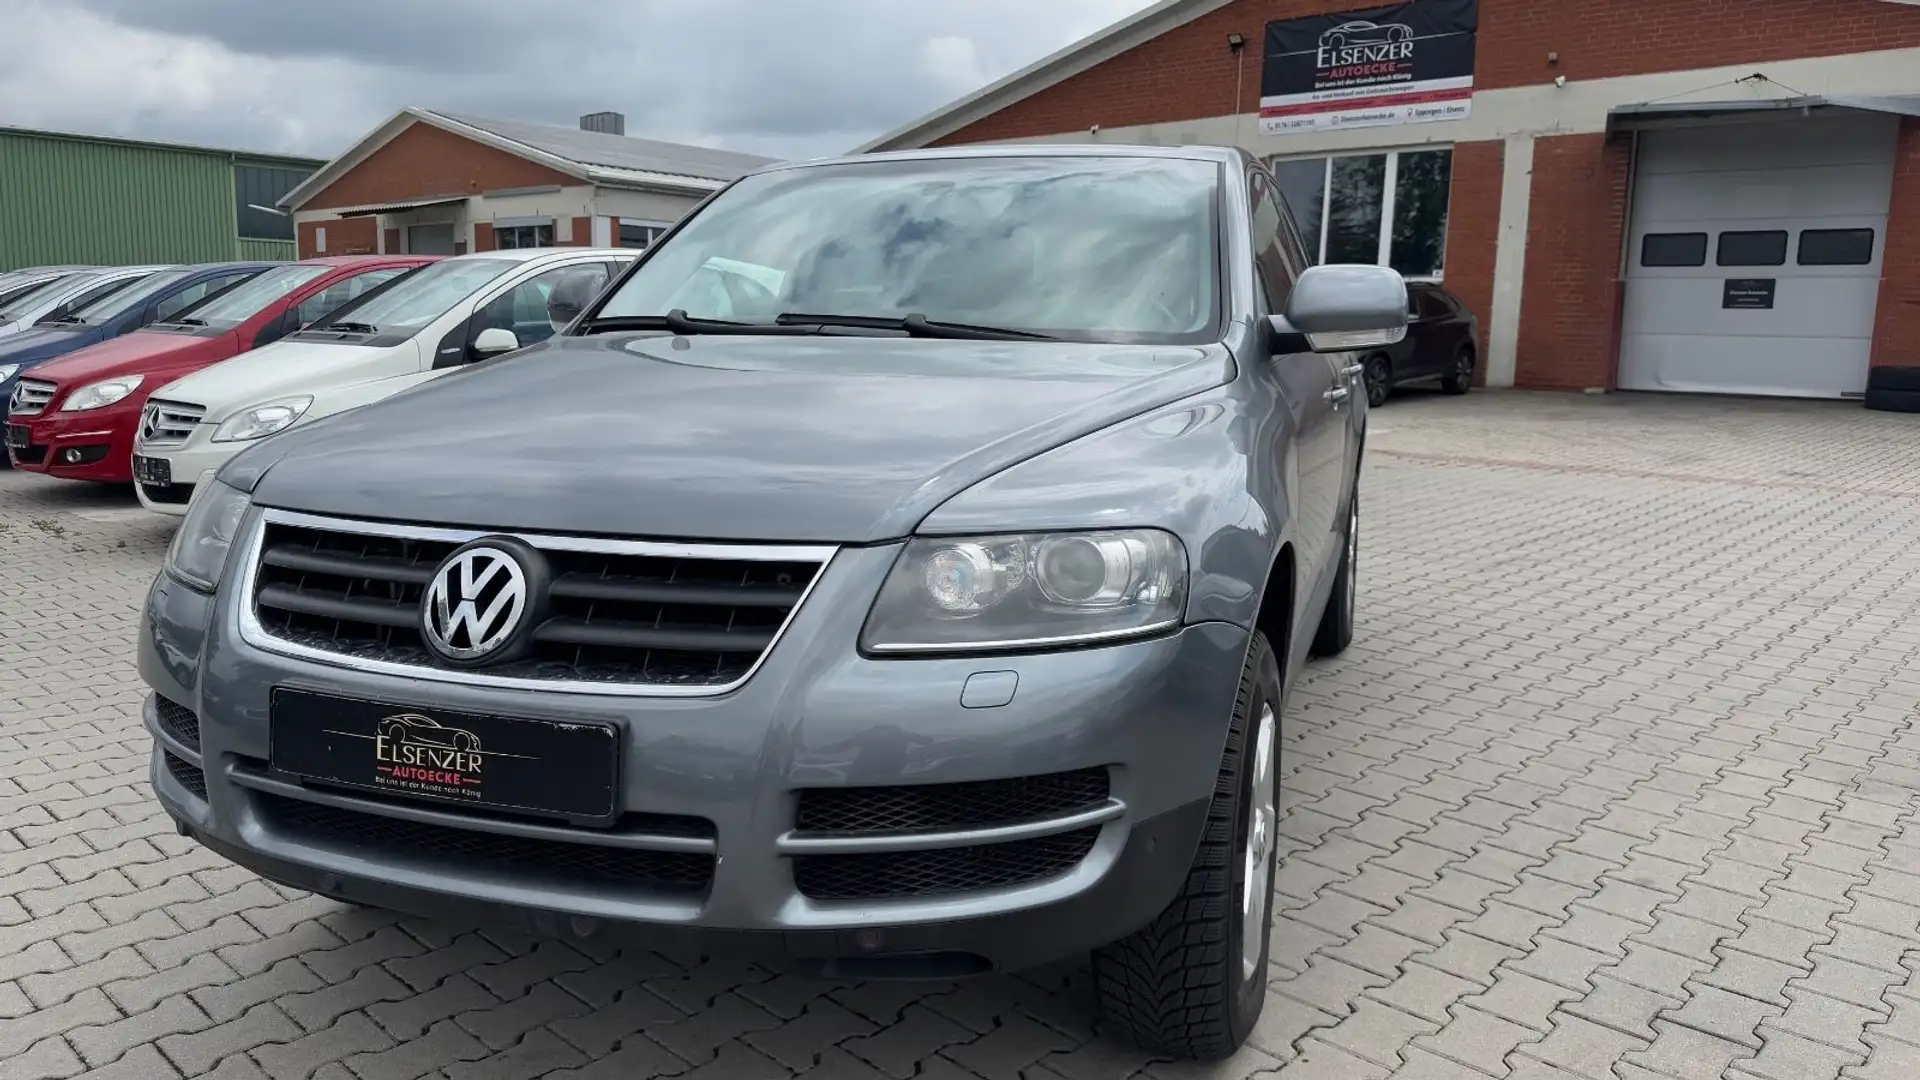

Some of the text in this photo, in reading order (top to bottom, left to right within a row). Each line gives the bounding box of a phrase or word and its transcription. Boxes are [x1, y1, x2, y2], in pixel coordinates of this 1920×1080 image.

[1317, 41, 1413, 68] ELSENZER
[1330, 62, 1397, 78] AUTOECKE
[1356, 76, 1376, 84] Kunde
[428, 549, 522, 655] VW
[377, 735, 482, 773] ELSENZER
[375, 775, 385, 783] Bei
[400, 779, 408, 787] ist
[409, 781, 420, 789] der
[421, 782, 442, 792] Kunde
[462, 788, 482, 799] König
[393, 765, 461, 785] AUTOECKE
